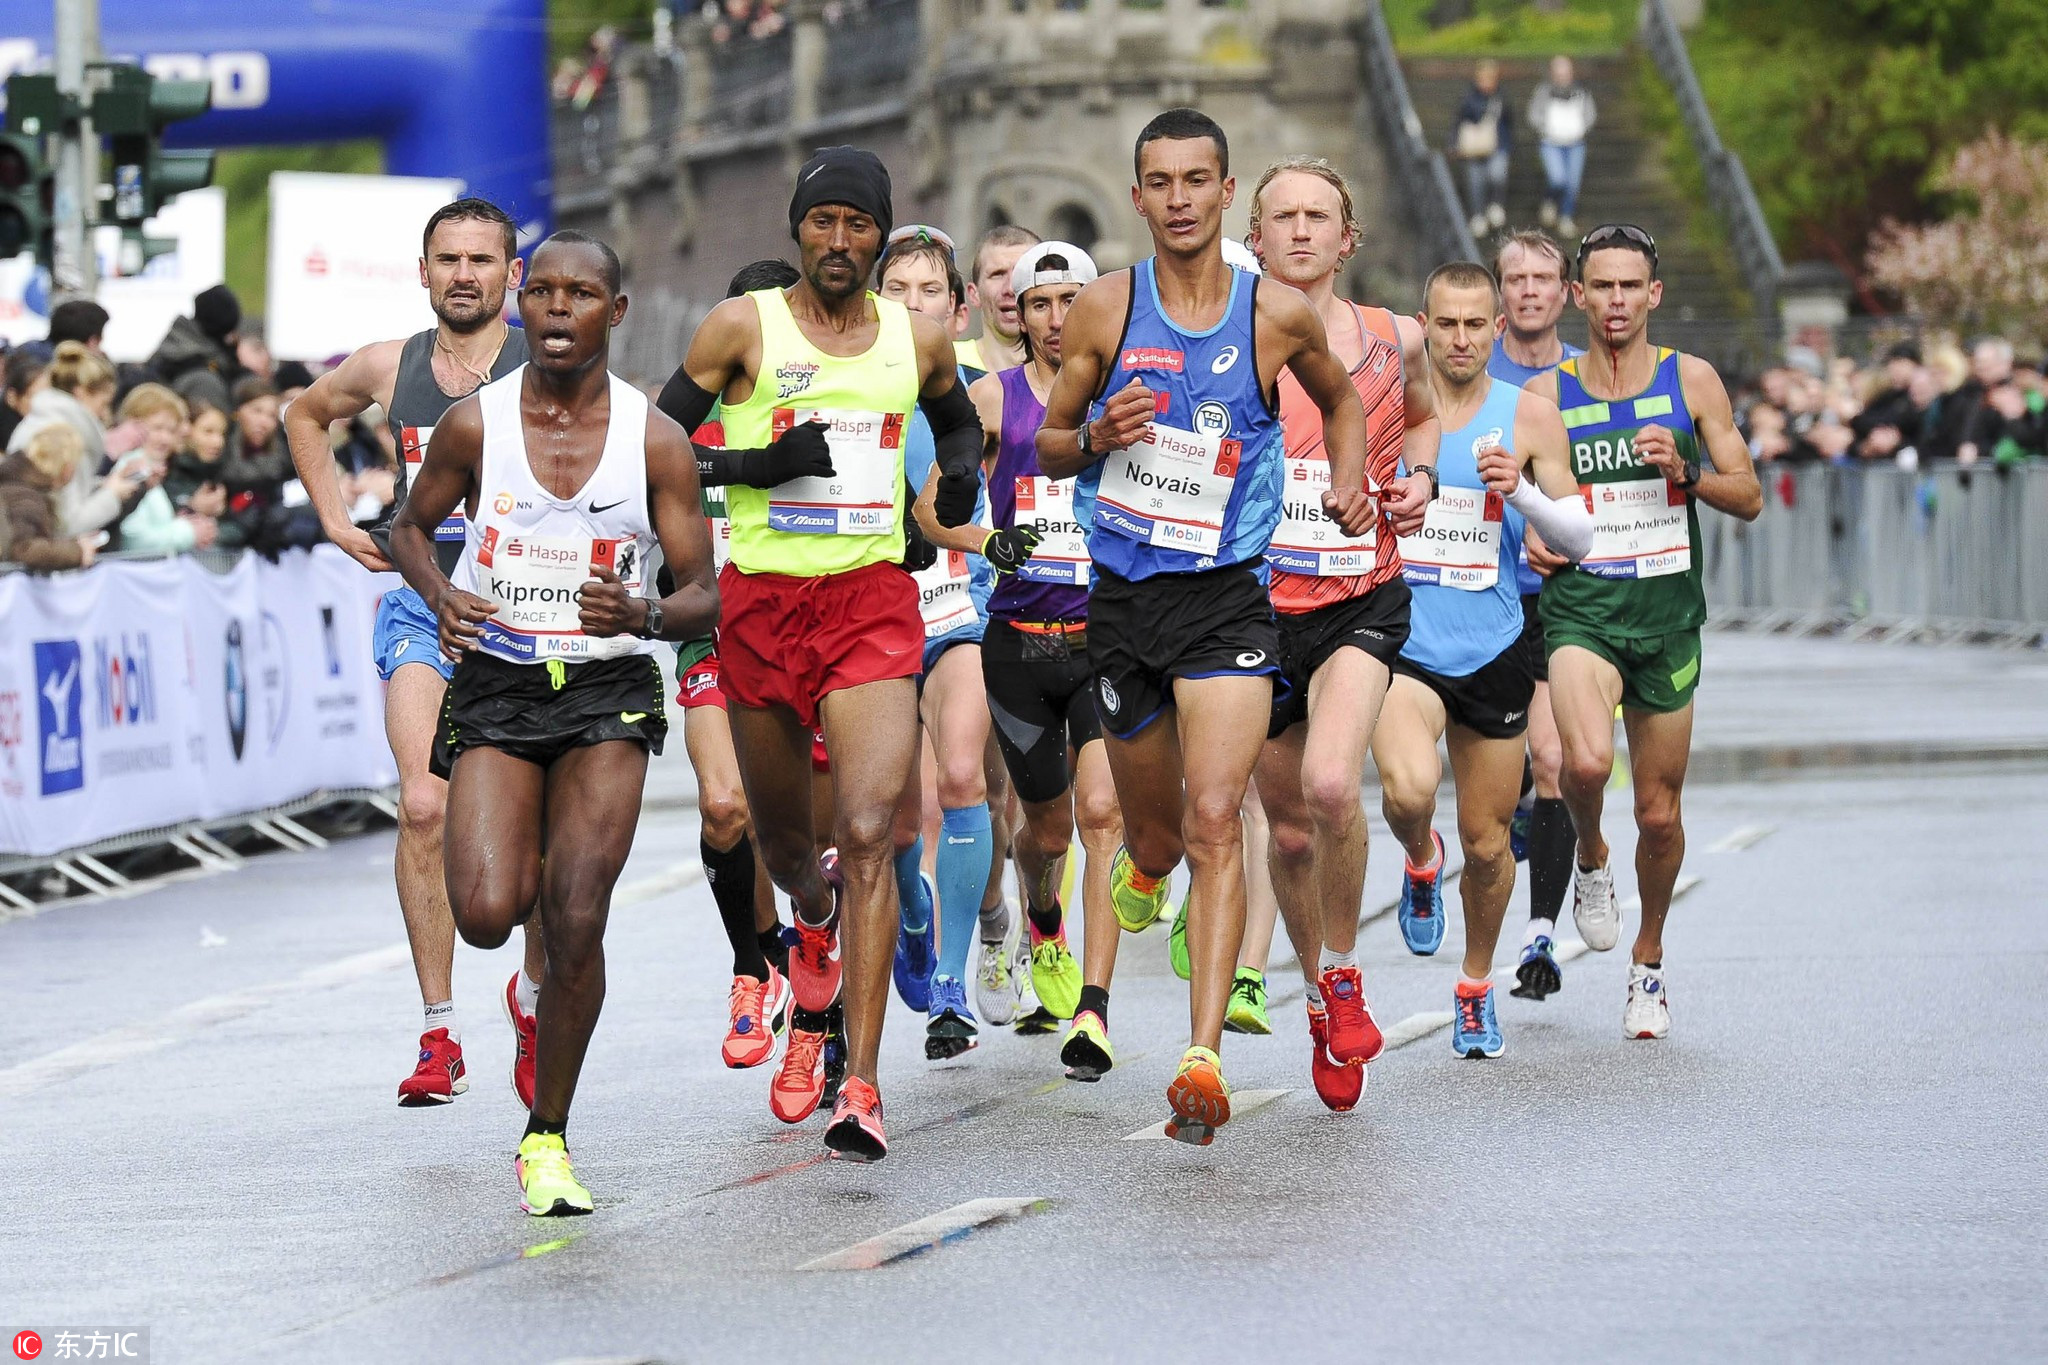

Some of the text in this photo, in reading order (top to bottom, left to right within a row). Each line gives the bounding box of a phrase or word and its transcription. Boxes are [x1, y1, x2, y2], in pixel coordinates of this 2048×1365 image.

[783, 361, 820, 371] Schuhe
[1138, 353, 1180, 366] Santander
[776, 369, 815, 382] Berger
[776, 377, 811, 398] Sport
[829, 418, 872, 436] Haspa
[1160, 435, 1207, 458] Haspa
[1125, 460, 1202, 496] Novais
[829, 485, 843, 495] 62
[1619, 489, 1658, 503] Haspa
[516, 502, 533, 510] NN
[1149, 498, 1163, 508] 36
[1436, 495, 1474, 509] Haspa
[849, 512, 881, 525] Mobil
[1633, 514, 1681, 531] Andrade
[1035, 518, 1082, 534] Barz
[1163, 525, 1202, 543] Mobil
[1312, 531, 1325, 541] 32
[1414, 527, 1489, 543] losevic
[529, 544, 578, 563] Haspa
[1068, 542, 1081, 552] 20
[1434, 548, 1446, 557] 24
[1329, 555, 1361, 566] Mobil
[1645, 555, 1677, 568] Mobil
[1450, 571, 1482, 581] Mobil
[919, 583, 961, 604] gam
[512, 611, 558, 623] PACE 7
[931, 615, 964, 636] Mobil
[547, 639, 589, 652] Mobil
[94, 631, 156, 729] Mobil
